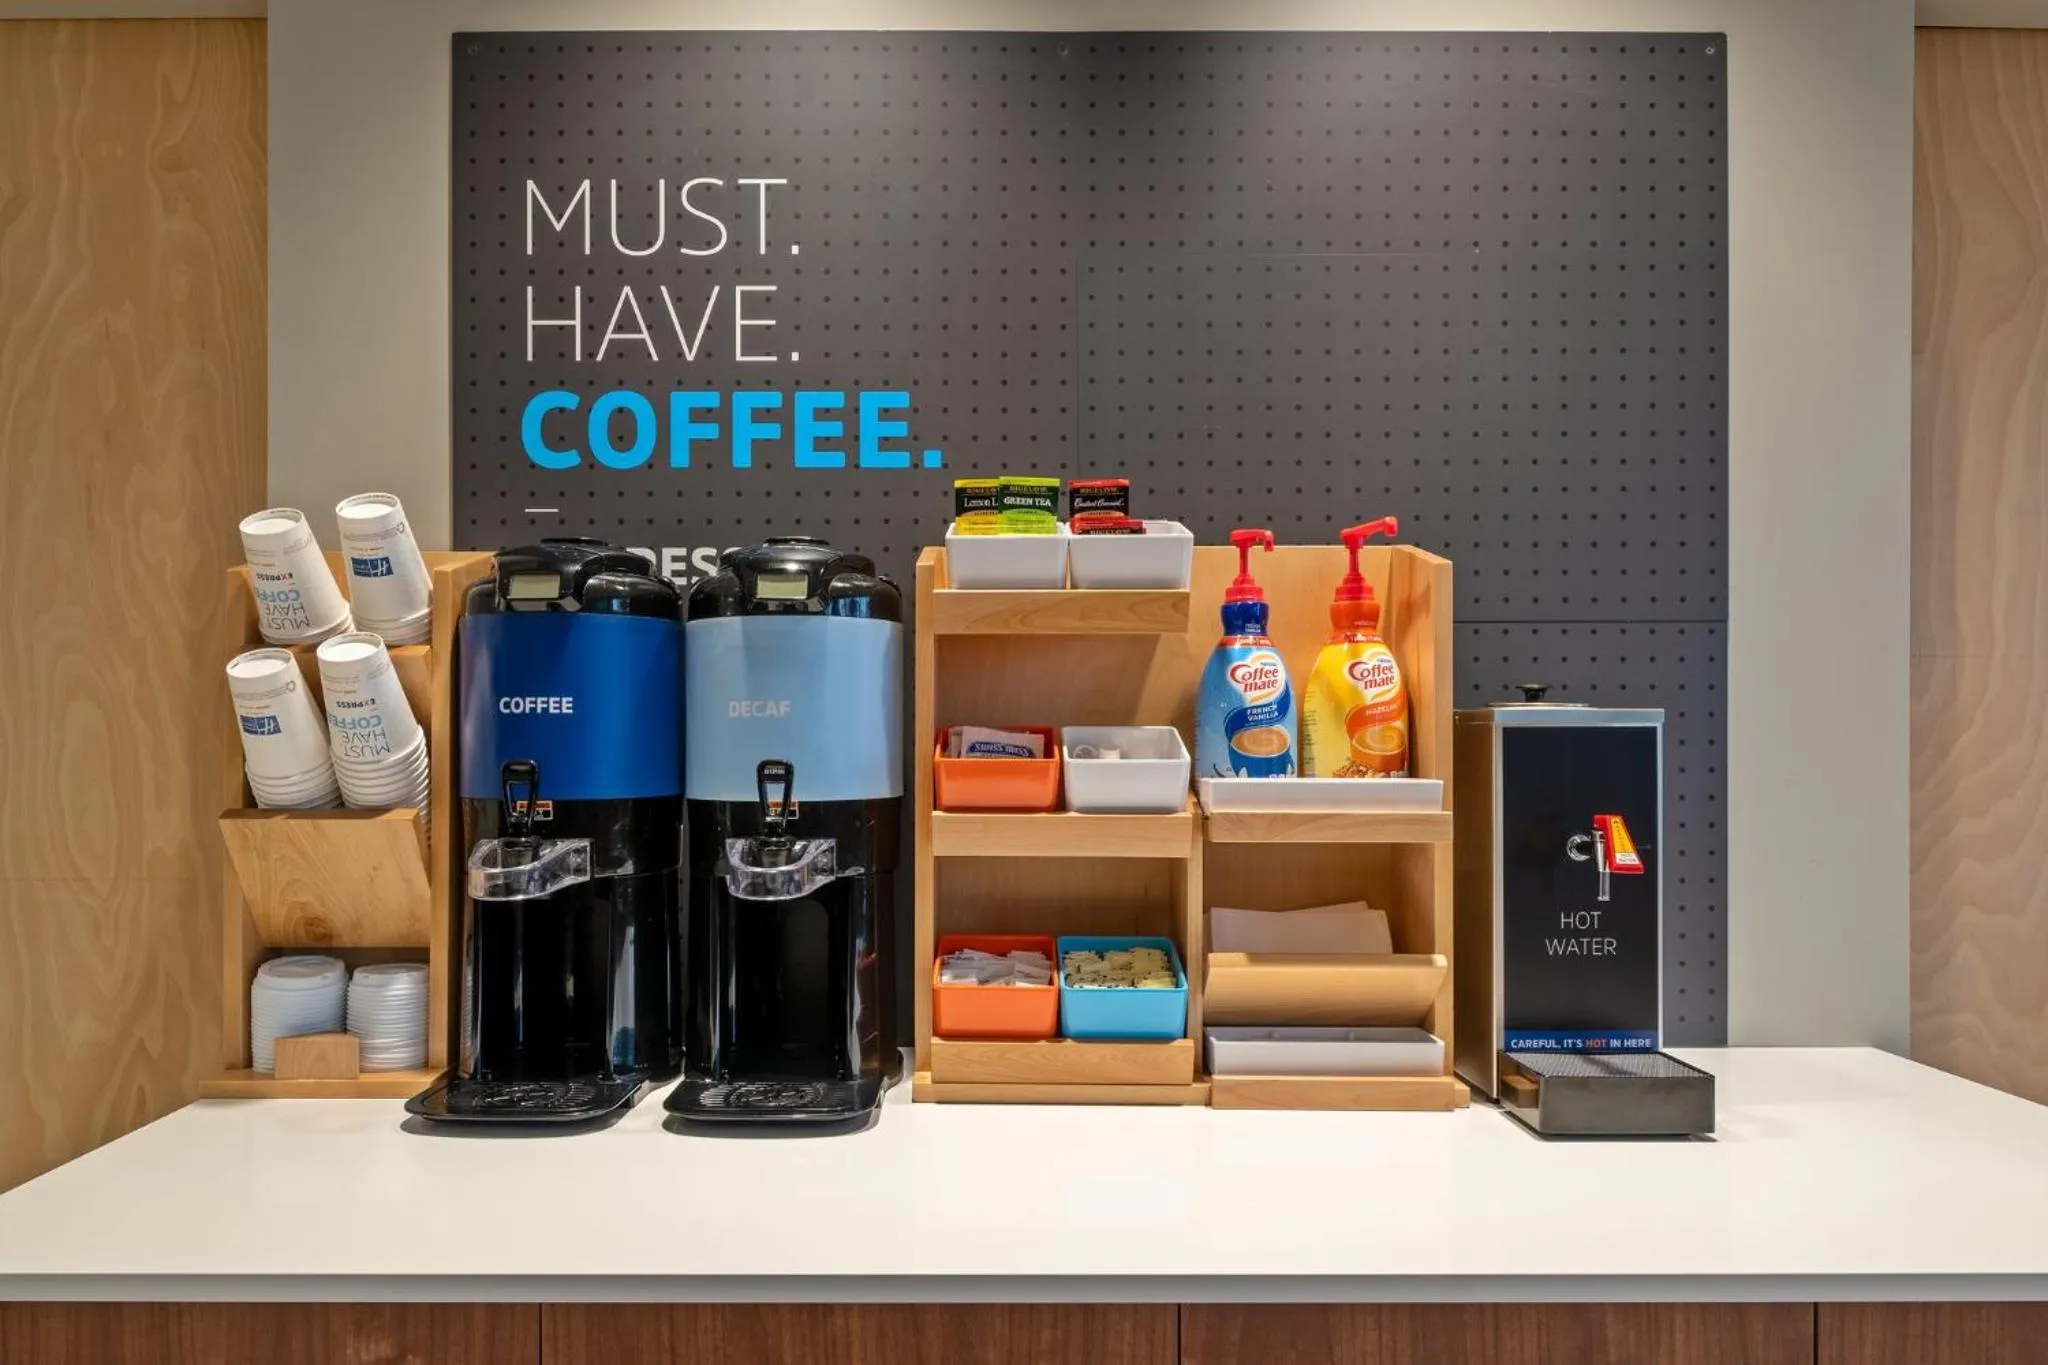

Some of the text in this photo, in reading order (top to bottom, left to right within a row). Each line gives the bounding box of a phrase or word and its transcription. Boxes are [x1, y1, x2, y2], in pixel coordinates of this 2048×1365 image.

[526, 178, 801, 257] MUST.
[526, 285, 801, 363] HAVE.
[521, 390, 943, 470] COFFEE.
[1003, 496, 1052, 507] GREEN TEA
[1230, 663, 1279, 685] Coffee
[1348, 661, 1396, 682] Coffee
[1243, 679, 1279, 693] mate
[1364, 675, 1396, 690] mate
[499, 696, 574, 715] COFFEE
[729, 699, 792, 719] DECAF
[341, 729, 386, 745] HAVE
[344, 744, 390, 759] MUST
[1560, 912, 1603, 930] HOT
[1545, 938, 1618, 956] WATER
[1511, 1039, 1652, 1049] CAREFUL, IT'S HOT IN HERE
